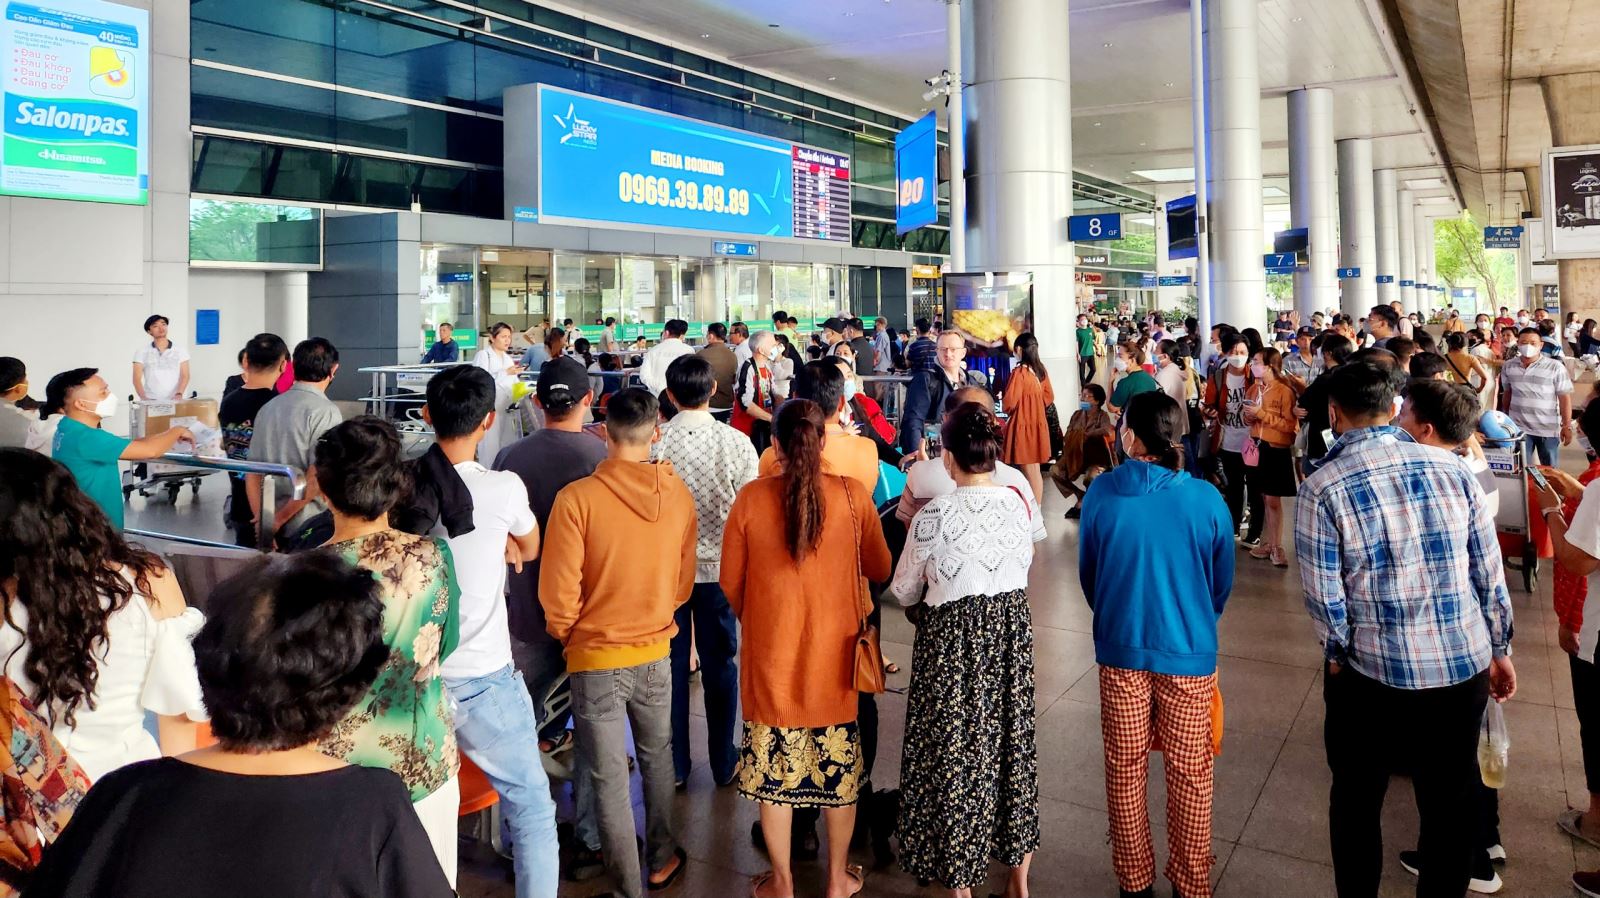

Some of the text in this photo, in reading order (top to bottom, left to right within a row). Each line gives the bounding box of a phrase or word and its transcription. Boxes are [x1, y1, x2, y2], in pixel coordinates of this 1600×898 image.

[98, 30, 114, 43] 40
[20, 48, 40, 58] Đau
[20, 58, 40, 68] Đau
[20, 67, 40, 78] Đau
[572, 130, 598, 140] STAR
[650, 150, 724, 176] MEDIA BOOKING
[618, 171, 750, 216] 0969.39.89.89
[1088, 218, 1102, 236] 8
[1276, 255, 1284, 266] 7
